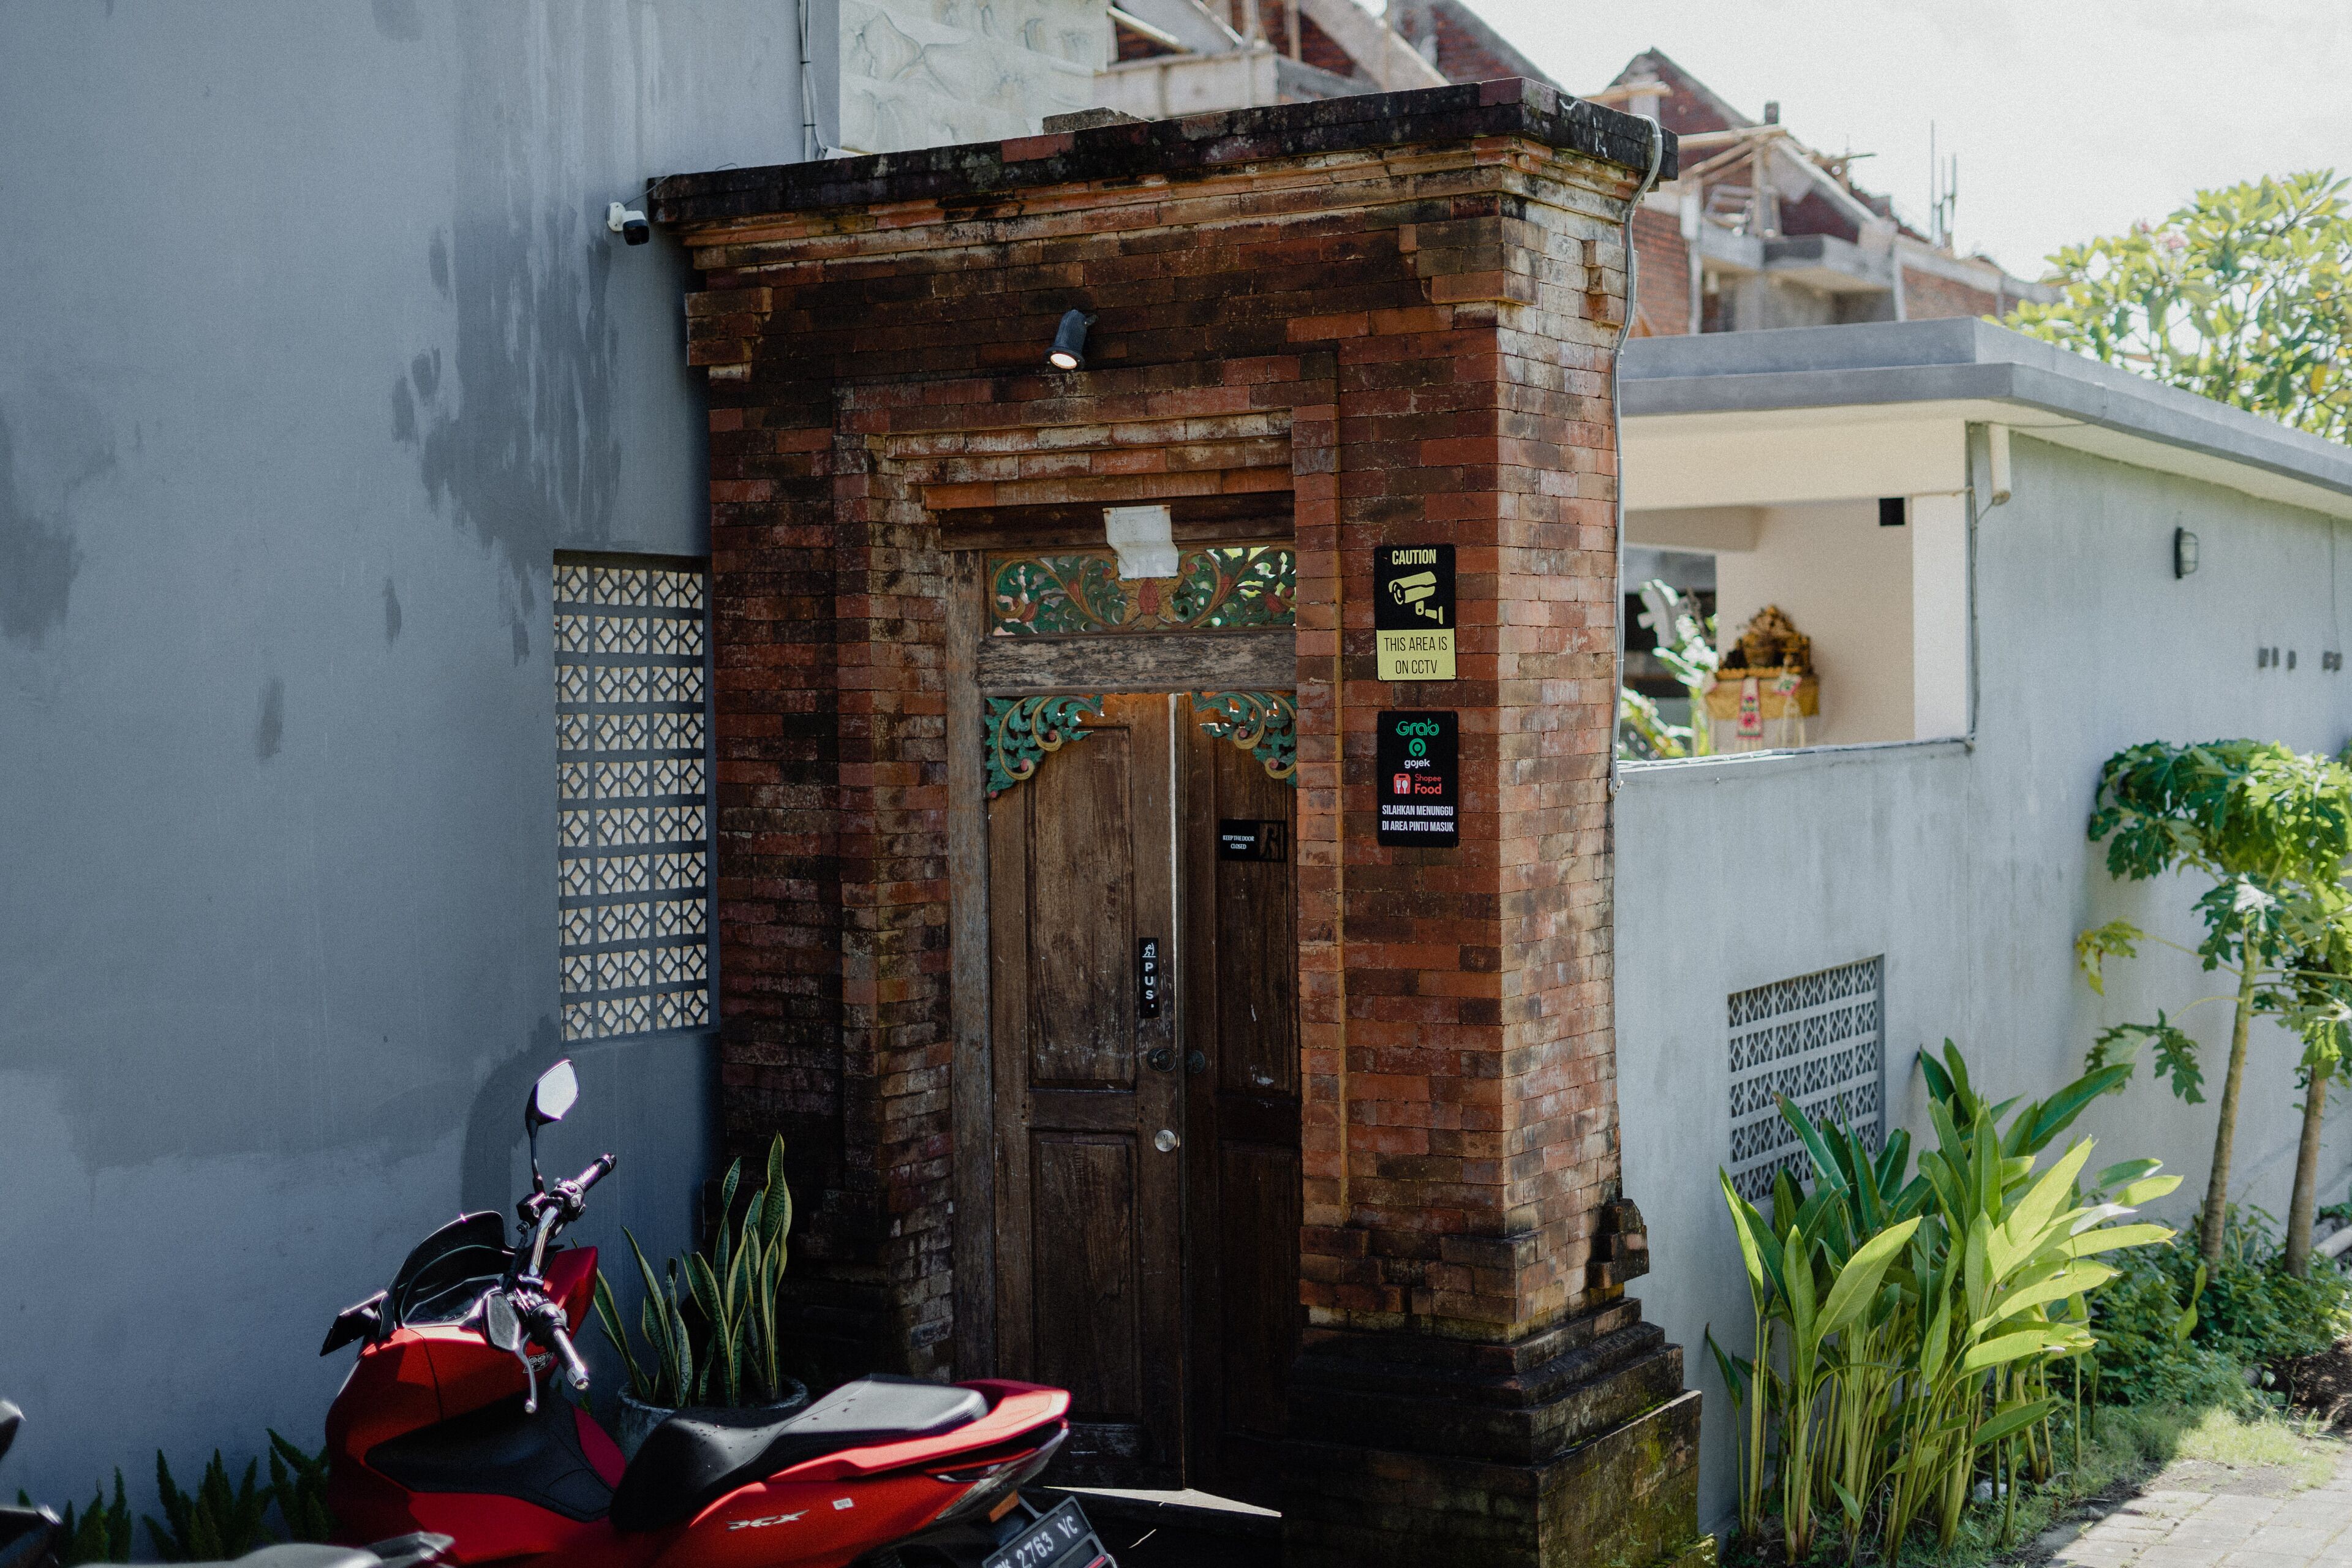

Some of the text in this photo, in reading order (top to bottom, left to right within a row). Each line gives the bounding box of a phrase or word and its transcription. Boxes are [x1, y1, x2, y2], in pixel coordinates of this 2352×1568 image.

[1392, 549, 1436, 565] CAUTION
[1384, 636, 1447, 651] THIS AREA IS
[1395, 660, 1438, 674] ON CCTV
[1396, 718, 1439, 736] Grab
[1404, 759, 1430, 769] gojek
[1415, 774, 1441, 783] Shopee
[1415, 783, 1442, 794] Food
[1382, 805, 1453, 816] SILAHKAN MENUNGGU
[1382, 821, 1454, 832] DI AREA PINTU MASUK
[1017, 1515, 1078, 1568] 2763 VC
